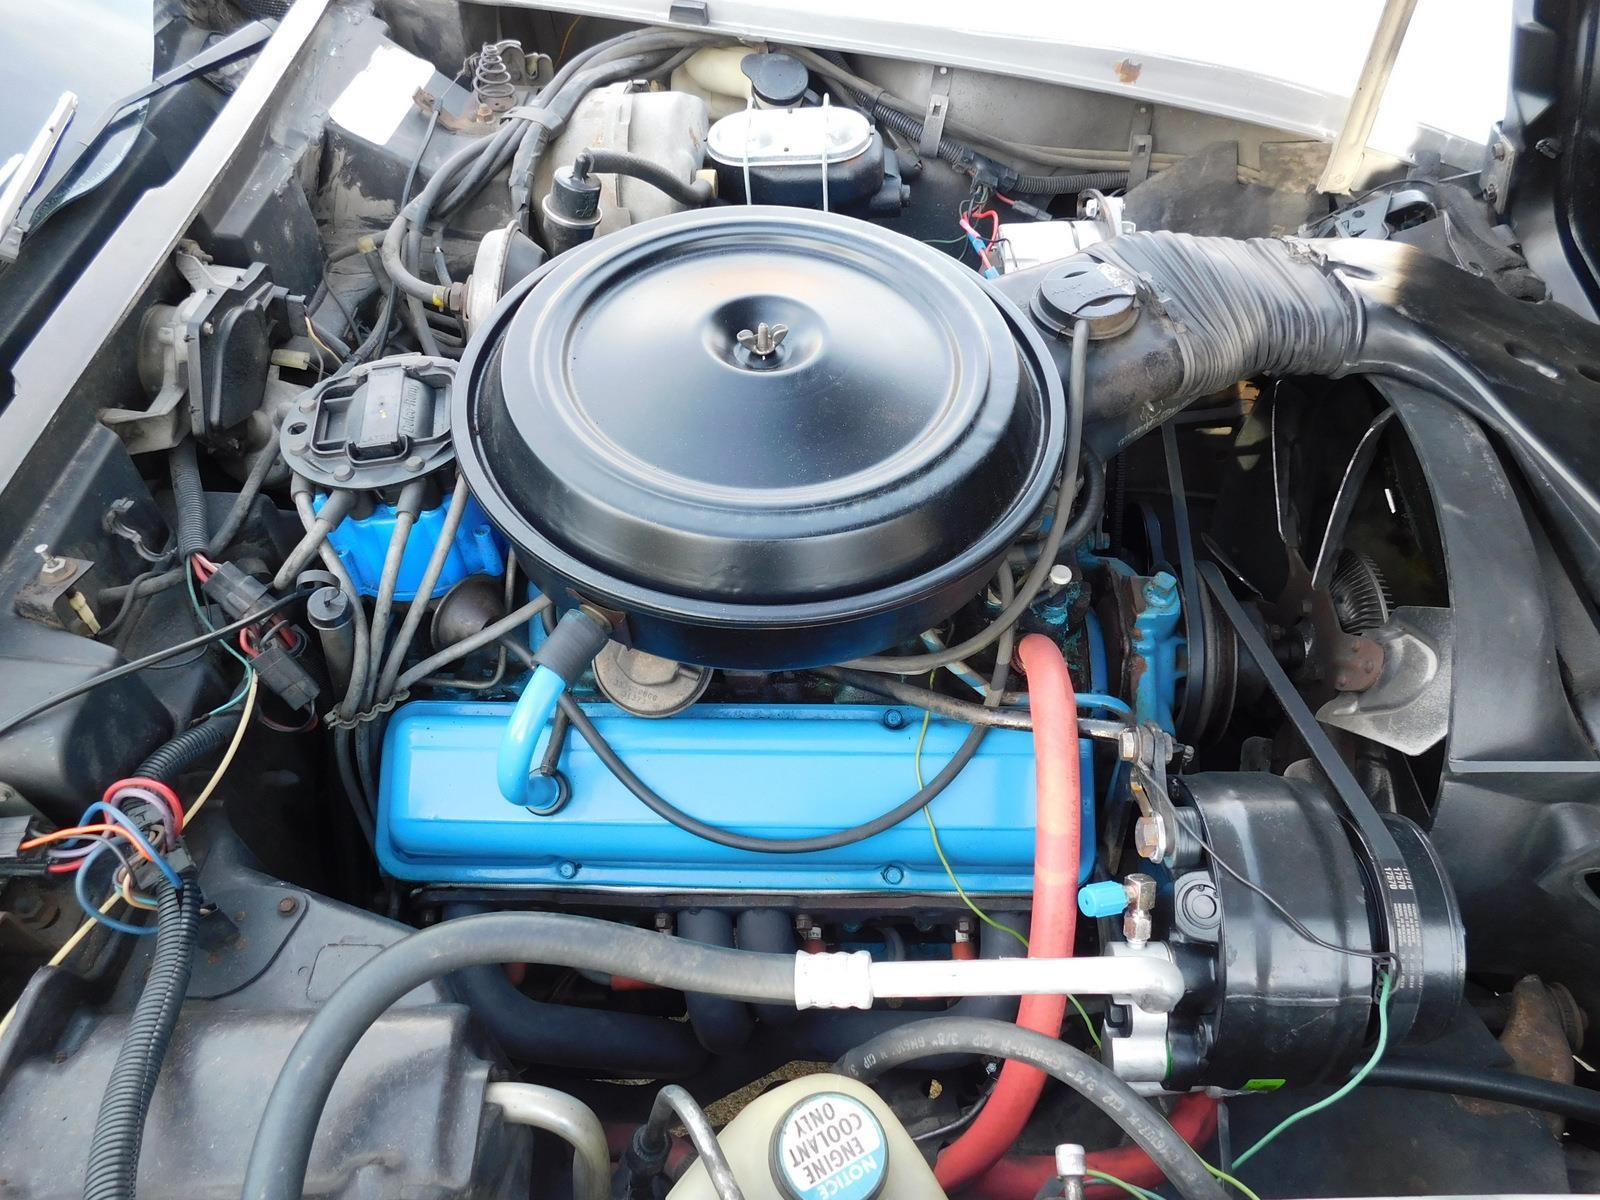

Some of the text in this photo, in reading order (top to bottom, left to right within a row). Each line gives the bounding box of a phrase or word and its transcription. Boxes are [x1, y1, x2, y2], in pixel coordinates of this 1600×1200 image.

[1384, 866, 1398, 890] 17570
[1393, 866, 1407, 890] 17570
[788, 1112, 863, 1168] COOLANT
[794, 1102, 835, 1138] ONLY
[802, 1136, 866, 1185] ENGINE
[817, 1154, 878, 1200] NOTICE
